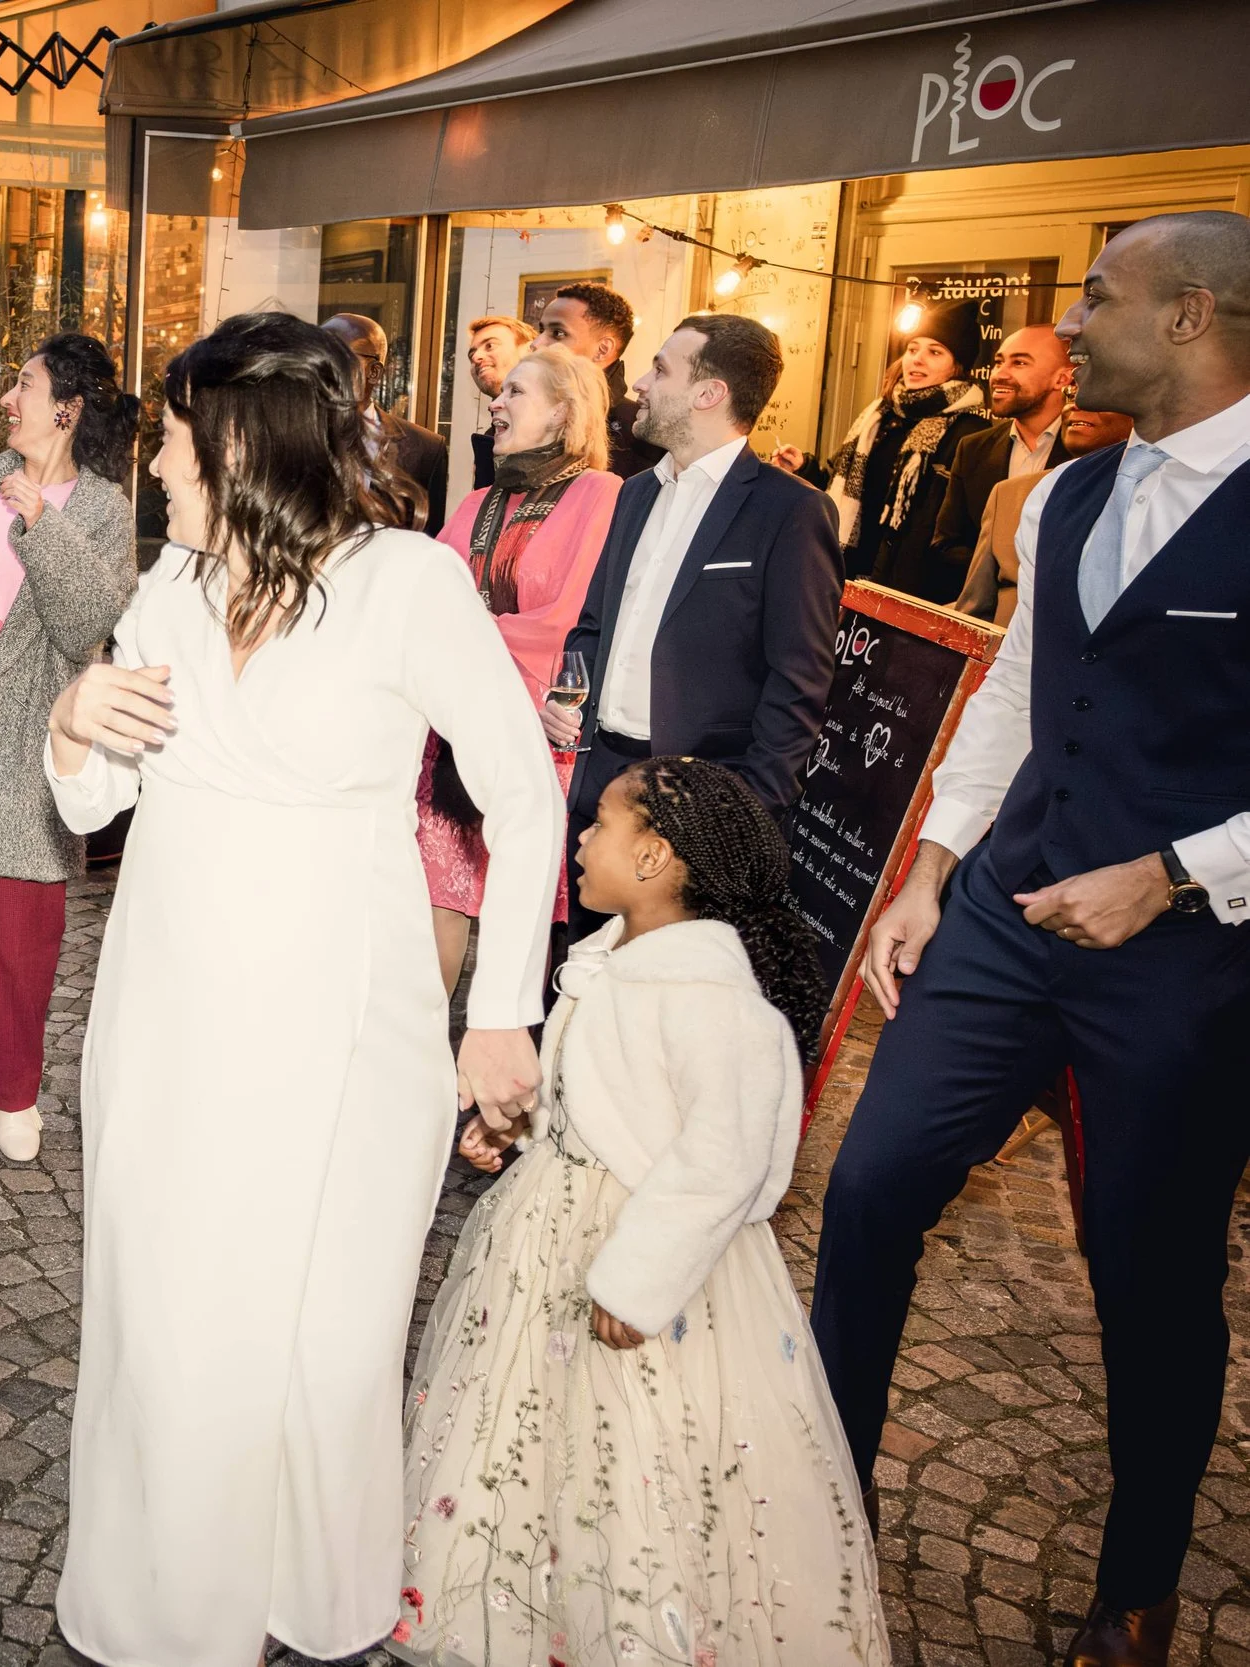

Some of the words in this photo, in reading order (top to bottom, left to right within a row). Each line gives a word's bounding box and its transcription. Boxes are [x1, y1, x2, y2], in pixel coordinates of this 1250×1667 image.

[911, 32, 1076, 163] PLOC
[906, 272, 1031, 300] Rstaurant
[980, 325, 1003, 340] Vin
[867, 688, 910, 718] aujourd'hui
[849, 727, 858, 742] de
[894, 753, 905, 768] et
[853, 871, 879, 885] moment
